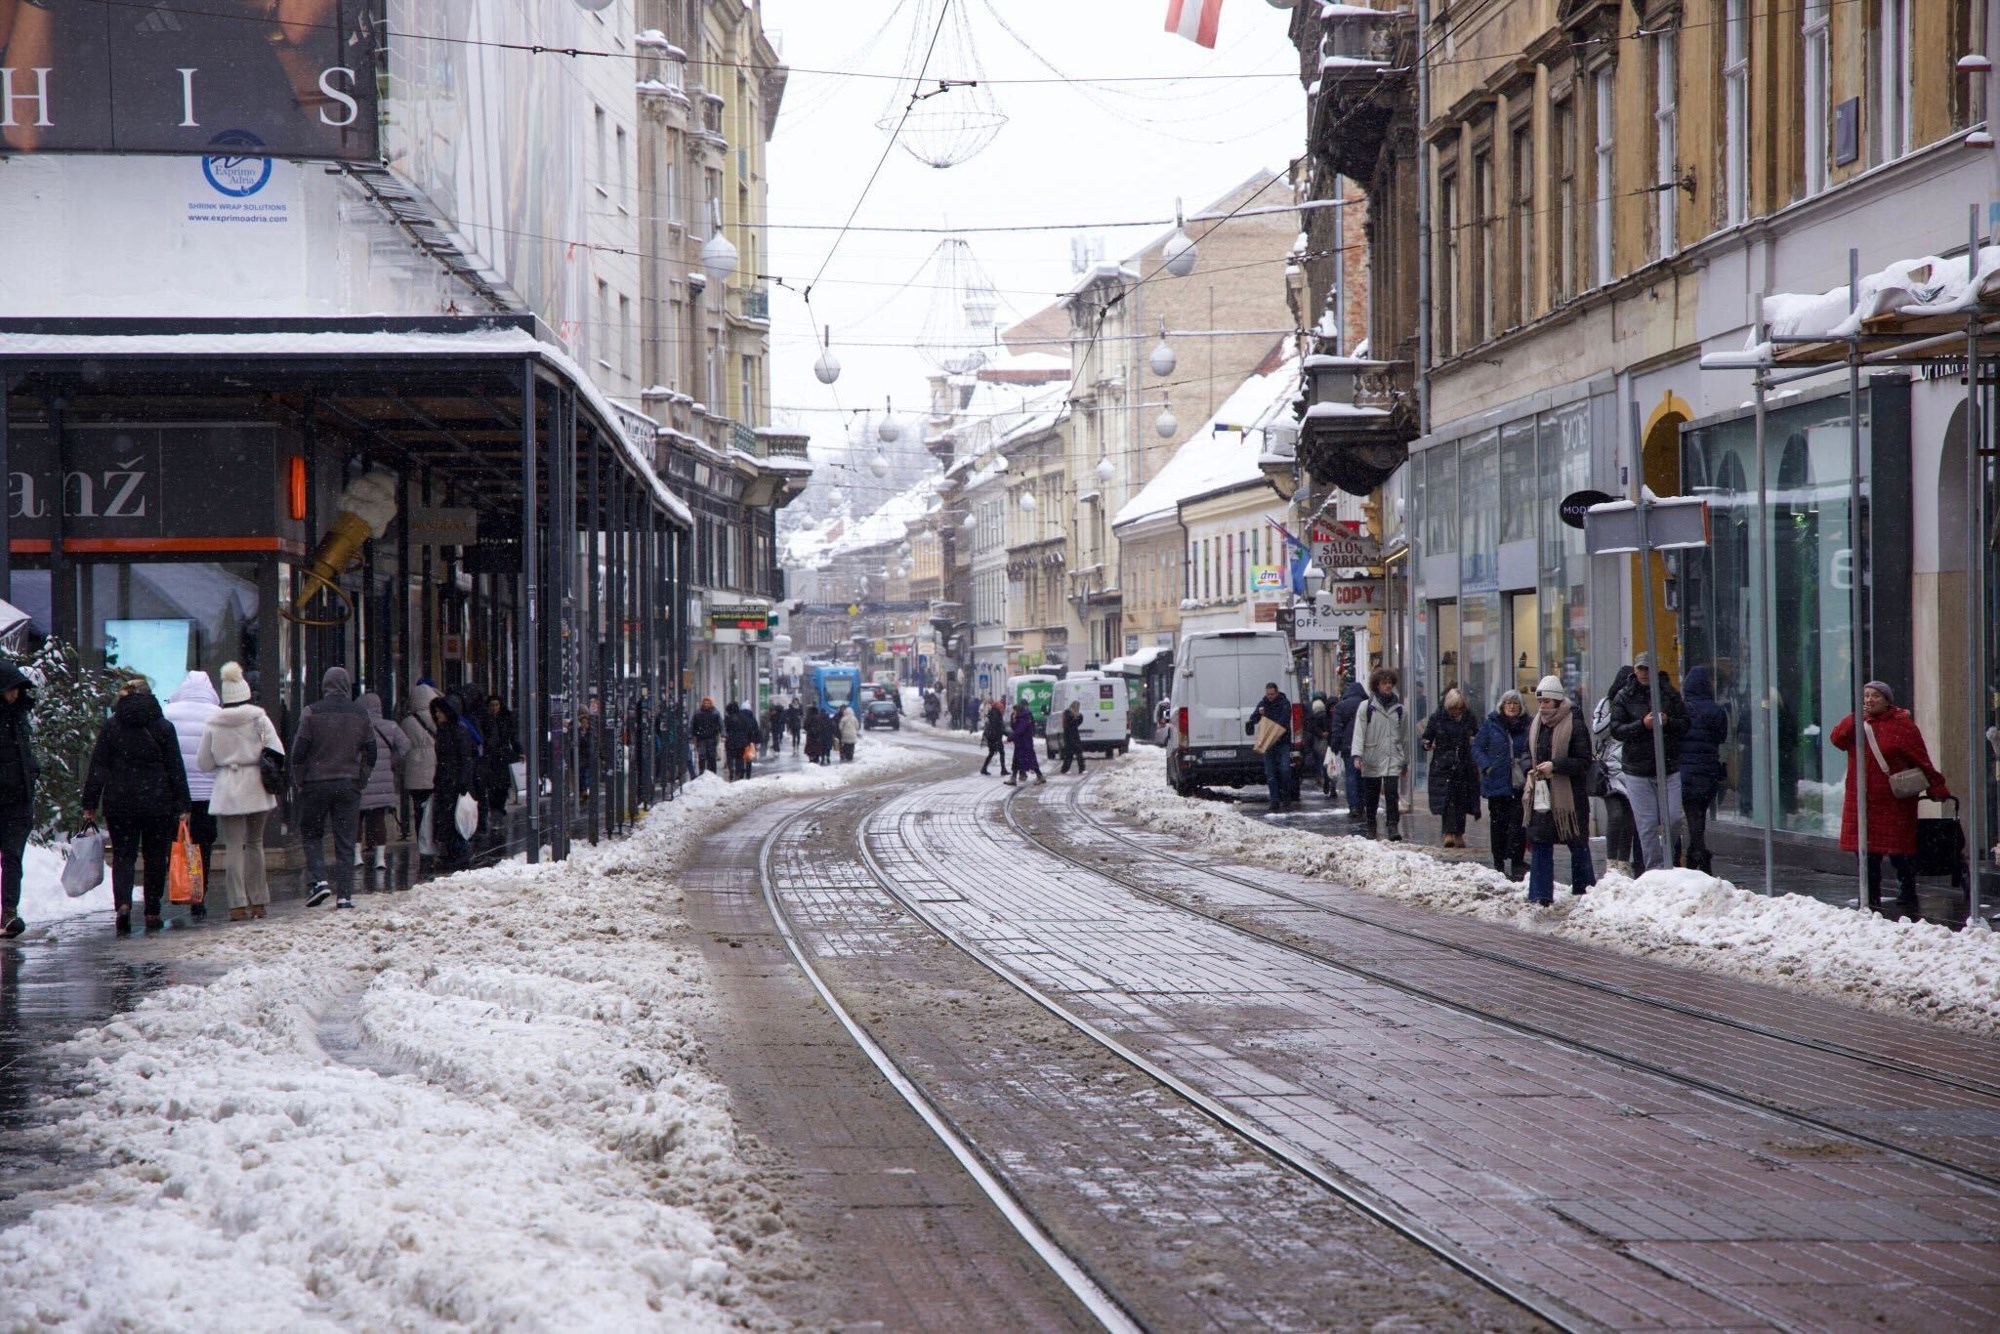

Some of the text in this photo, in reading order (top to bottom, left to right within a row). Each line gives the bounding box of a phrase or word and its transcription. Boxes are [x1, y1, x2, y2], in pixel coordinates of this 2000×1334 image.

[215, 165, 256, 177] Exprimo
[229, 176, 255, 185] Adria
[187, 214, 288, 223] www.exprimoadria.com
[1322, 541, 1363, 556] SALON
[1260, 569, 1278, 580] dm
[1336, 584, 1375, 604] COPY
[1296, 618, 1322, 628] OFF.
